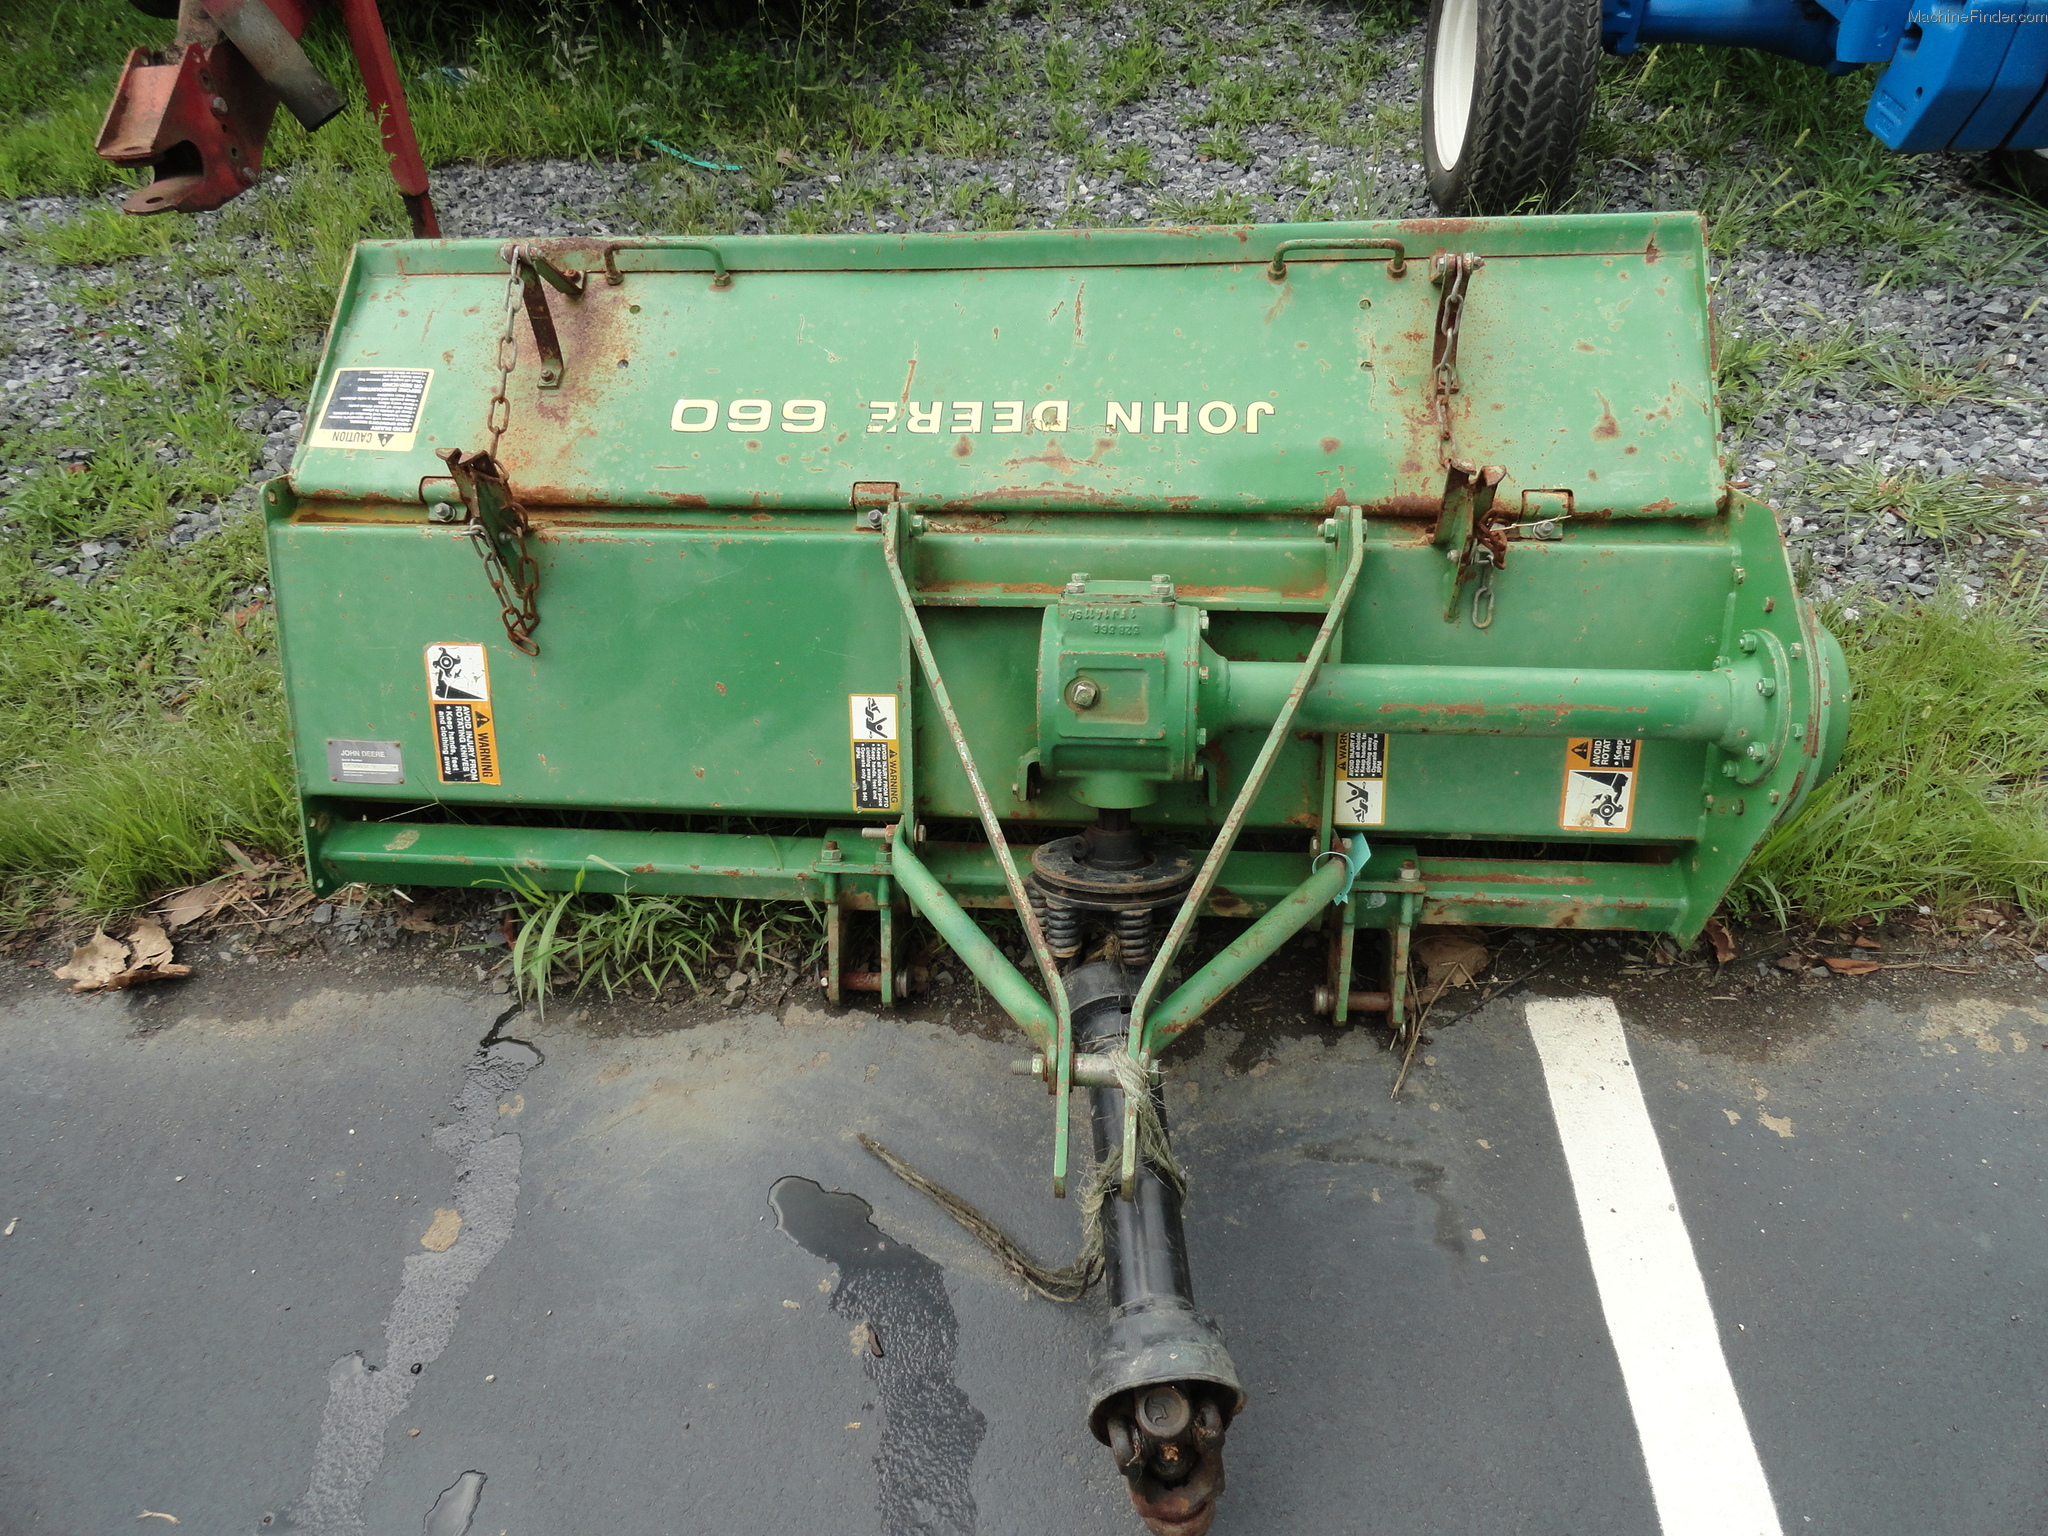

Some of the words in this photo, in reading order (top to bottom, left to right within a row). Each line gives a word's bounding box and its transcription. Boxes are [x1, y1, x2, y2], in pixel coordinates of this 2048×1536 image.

[668, 398, 828, 434] 660
[865, 399, 1070, 435] DEERE
[1104, 399, 1276, 435] JOHN
[332, 431, 373, 443] CAUTION
[438, 711, 446, 724] and
[445, 711, 454, 729] Keep
[462, 706, 472, 729] AVOID
[440, 726, 451, 754] clothing
[448, 732, 457, 755] hands,
[455, 706, 465, 743] ROTATING
[460, 745, 469, 771] KNIVES
[466, 731, 475, 757] INJURY
[1613, 740, 1624, 760] Keep
[451, 757, 459, 771] feet
[478, 733, 493, 777] WARNING
[1593, 740, 1602, 765] AVOID
[1601, 739, 1610, 765] ROTAT
[470, 759, 478, 780] FROM
[890, 760, 898, 803] WARNING
